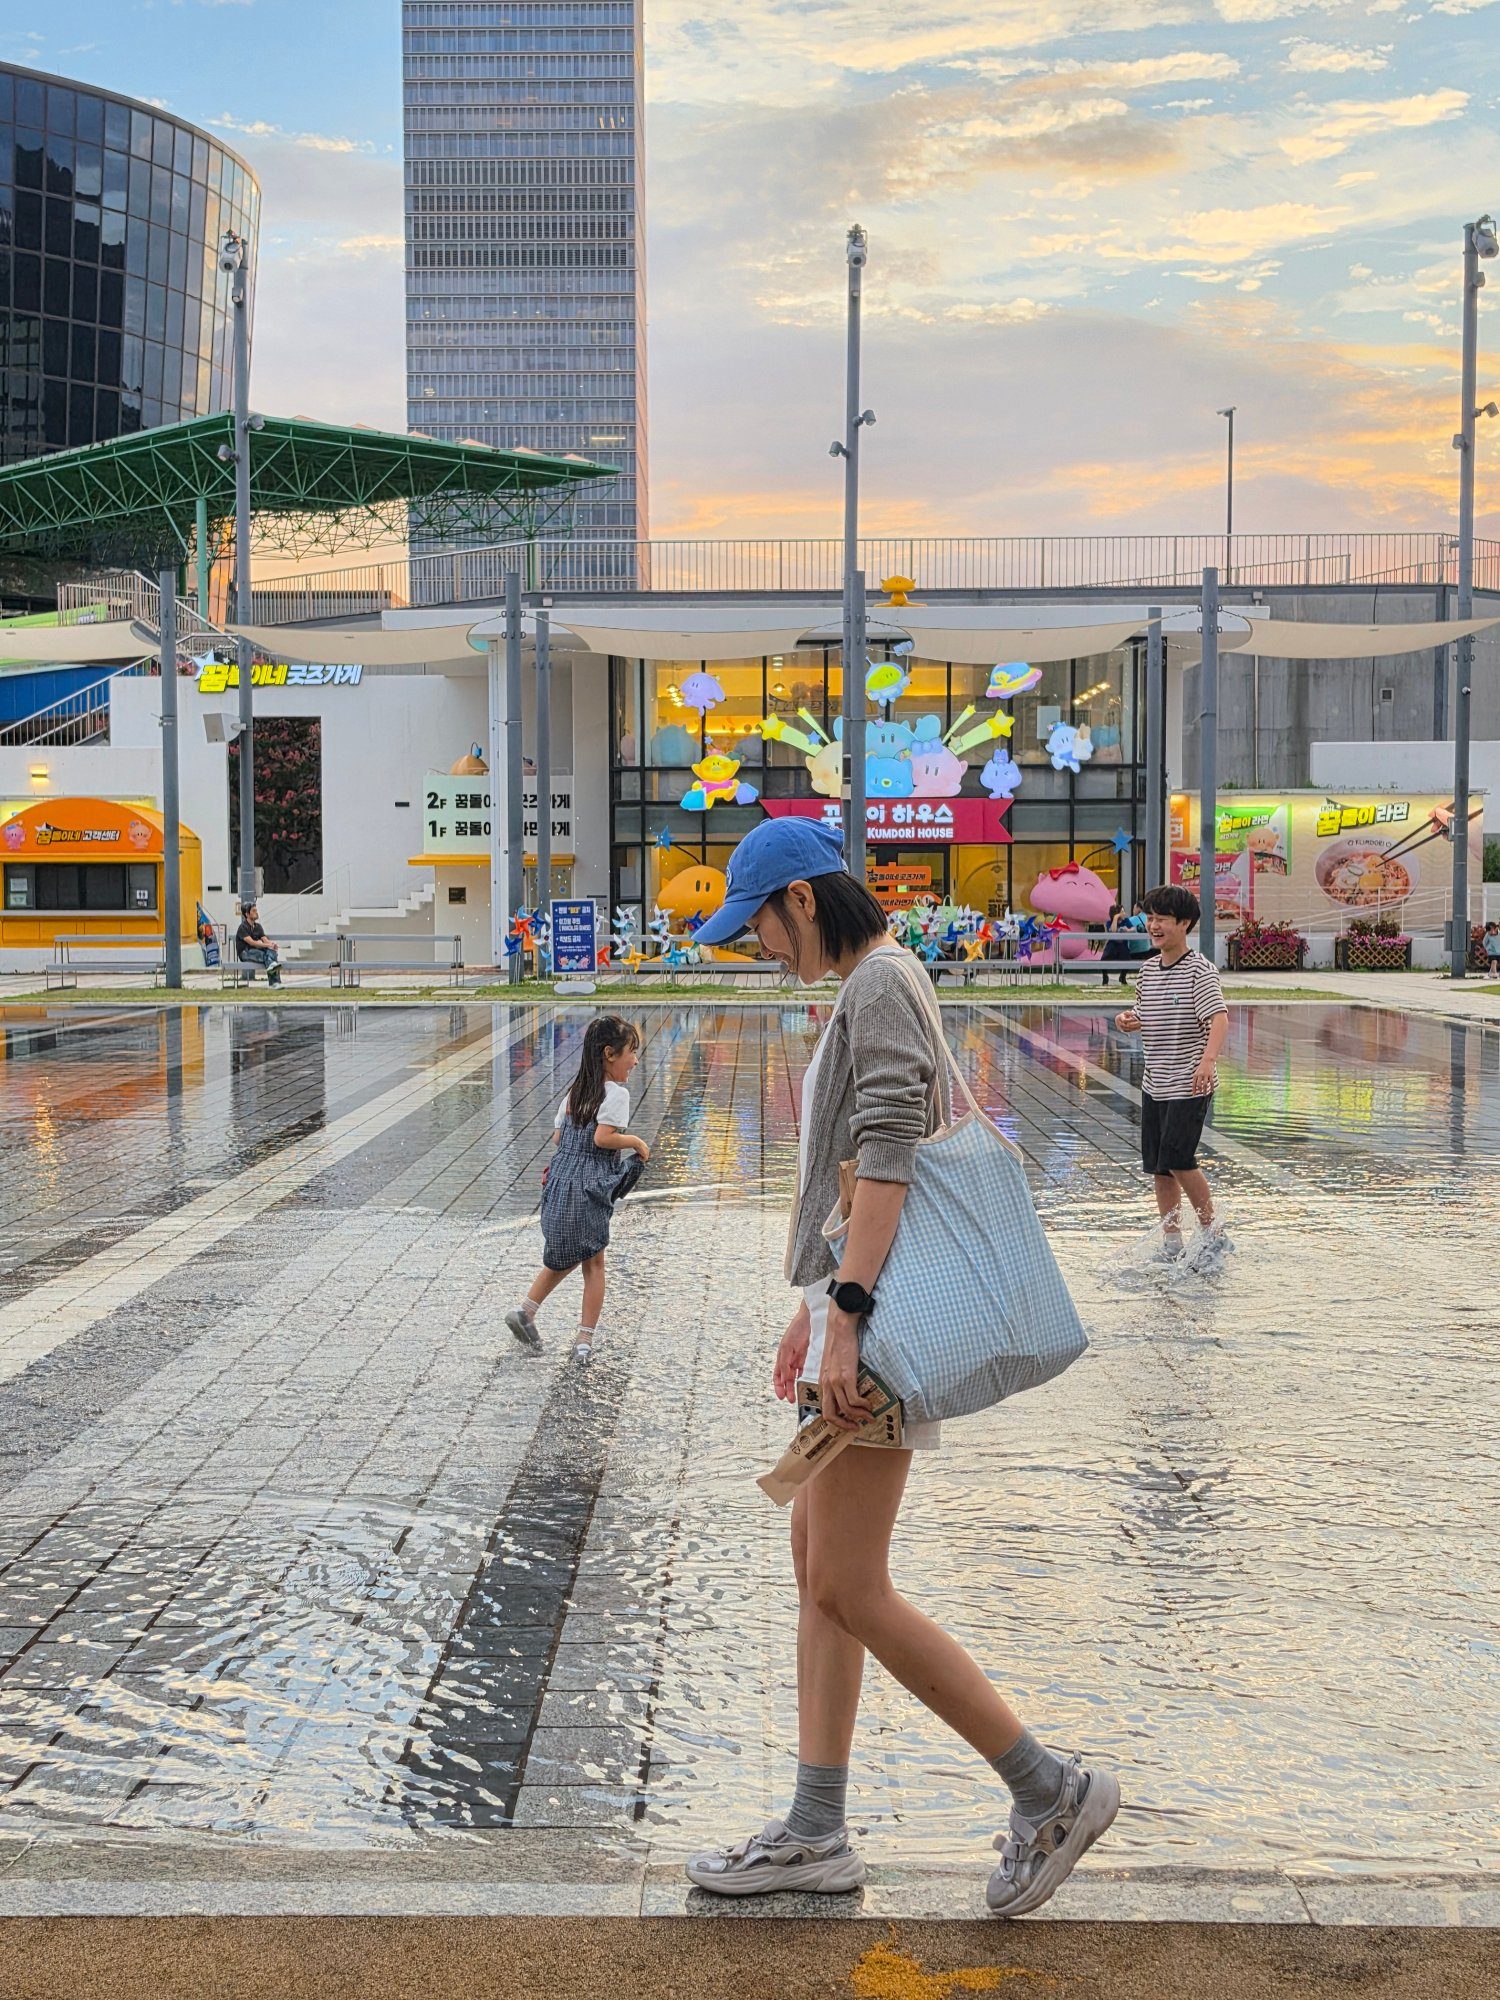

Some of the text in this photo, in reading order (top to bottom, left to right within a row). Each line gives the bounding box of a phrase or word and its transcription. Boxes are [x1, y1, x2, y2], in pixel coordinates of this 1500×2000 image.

[286, 664, 363, 686] 굿즈가게
[427, 791, 447, 809] 2F
[892, 803, 954, 824] 하우스
[1316, 802, 1410, 837] 꿈돌이 라면
[428, 820, 447, 837] 1F
[917, 827, 954, 840] HOUSE
